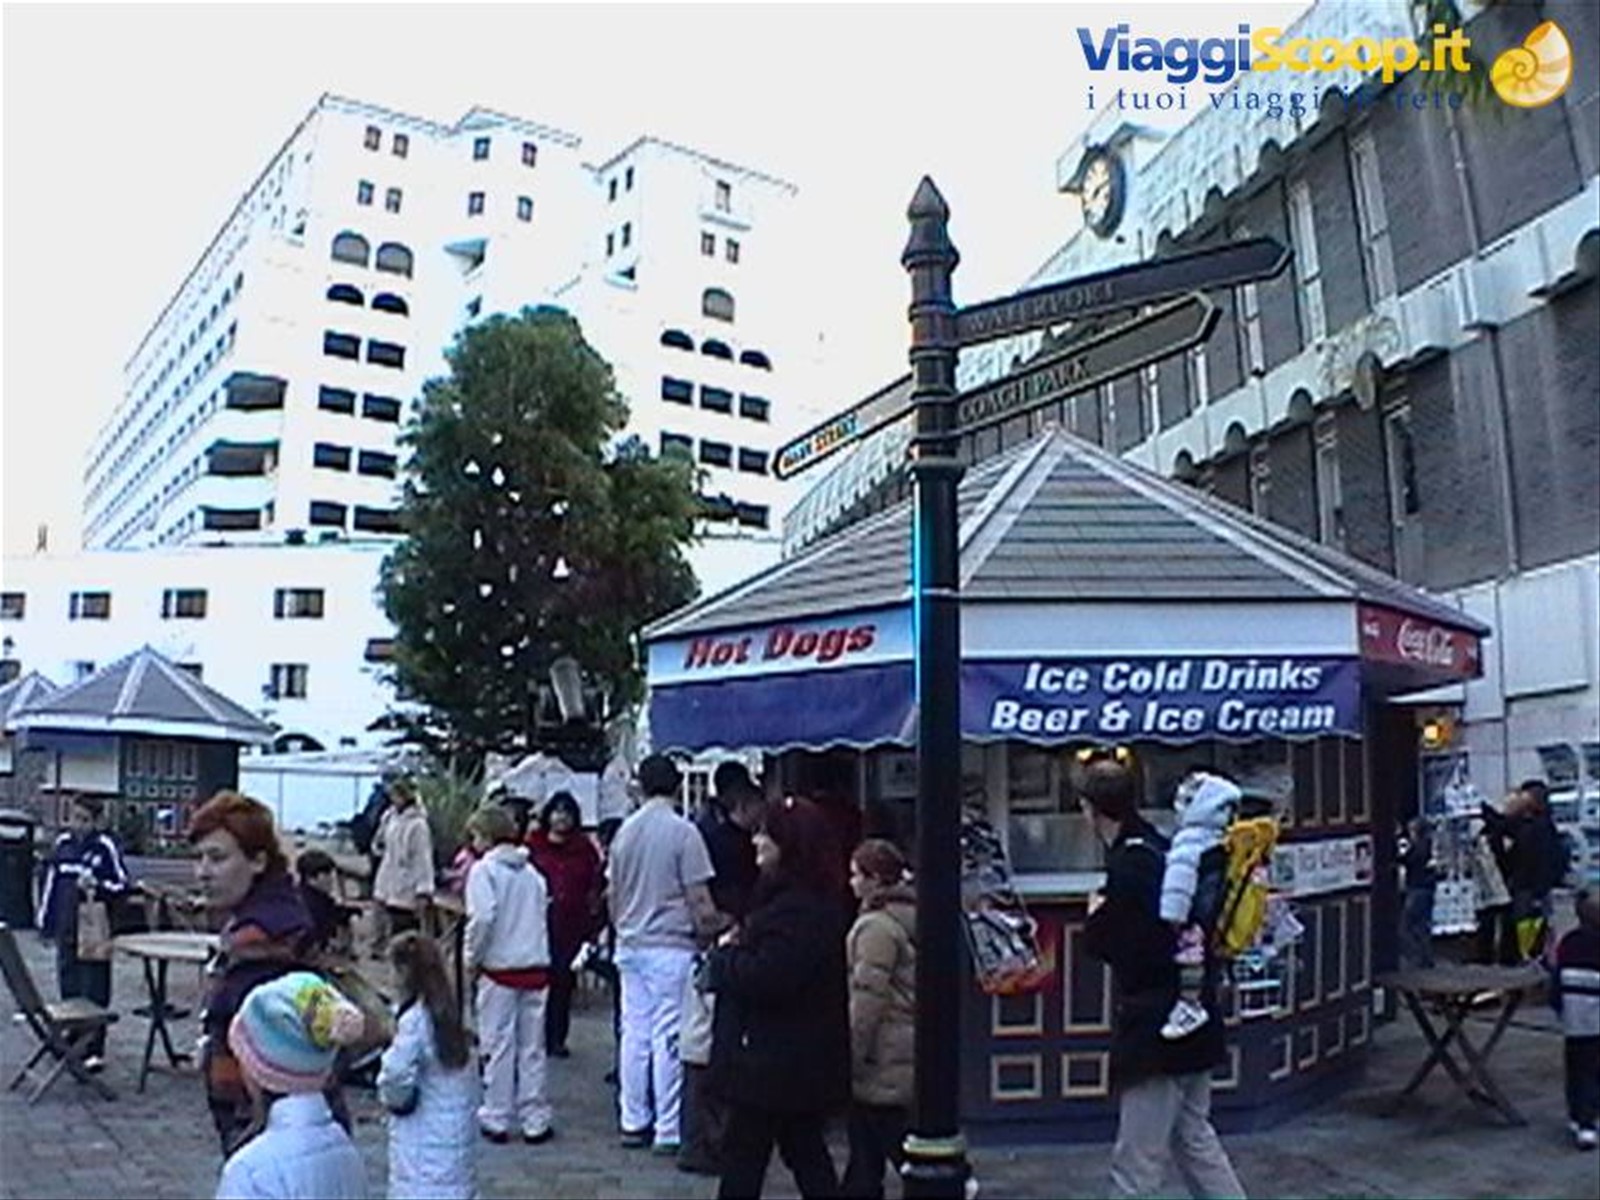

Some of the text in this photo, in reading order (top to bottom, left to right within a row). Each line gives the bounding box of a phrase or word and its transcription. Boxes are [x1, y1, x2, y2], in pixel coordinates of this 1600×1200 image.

[958, 354, 1091, 424] COACH PARK
[683, 622, 876, 670] Hot Dogs
[1024, 658, 1323, 692] Ice Cold Drinks
[991, 699, 1336, 732] Beer & Ice Cream
